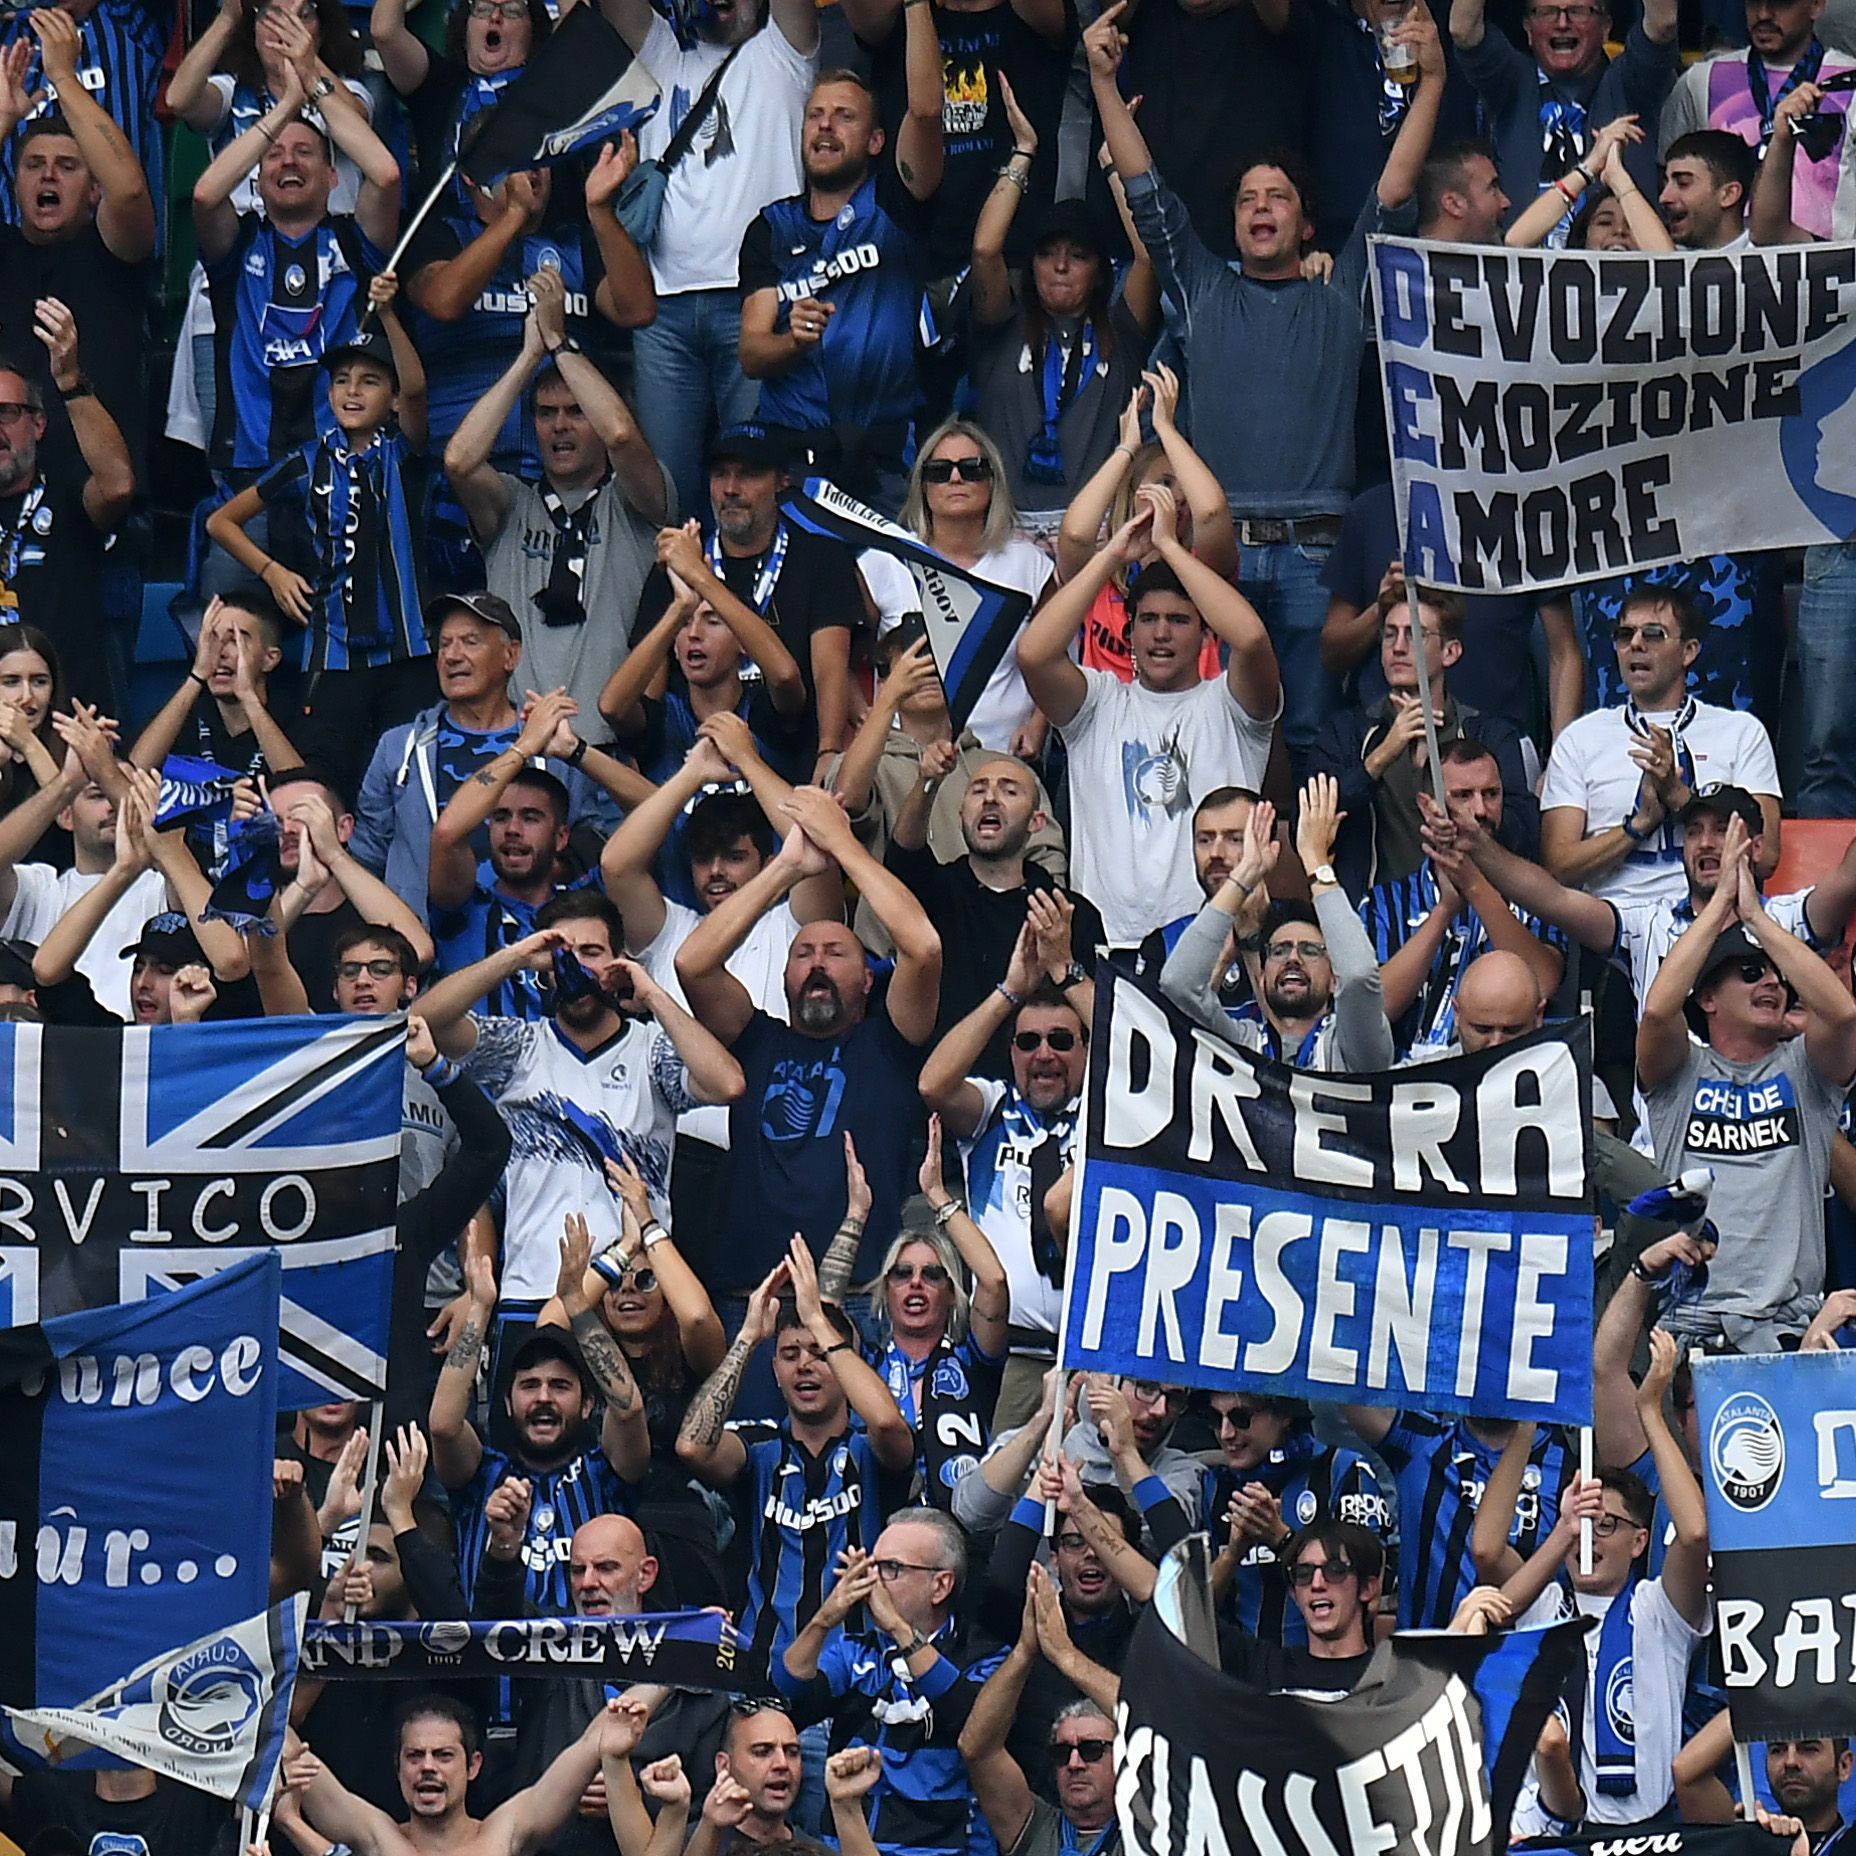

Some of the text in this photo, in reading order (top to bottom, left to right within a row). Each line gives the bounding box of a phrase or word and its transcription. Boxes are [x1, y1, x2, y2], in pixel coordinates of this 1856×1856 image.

[1375, 243, 1856, 366] DEVOZIONE
[1387, 356, 1801, 476] EMOZIONE
[1405, 455, 1682, 586] AMORE
[1103, 976, 1587, 1201] DRERA
[1686, 1116, 1791, 1150] SARNEK
[1749, 1085, 1783, 1116] DE
[1080, 1182, 1569, 1405] PRESENTE
[1731, 1481, 1767, 1501] 1907
[483, 1618, 670, 1671] CREW
